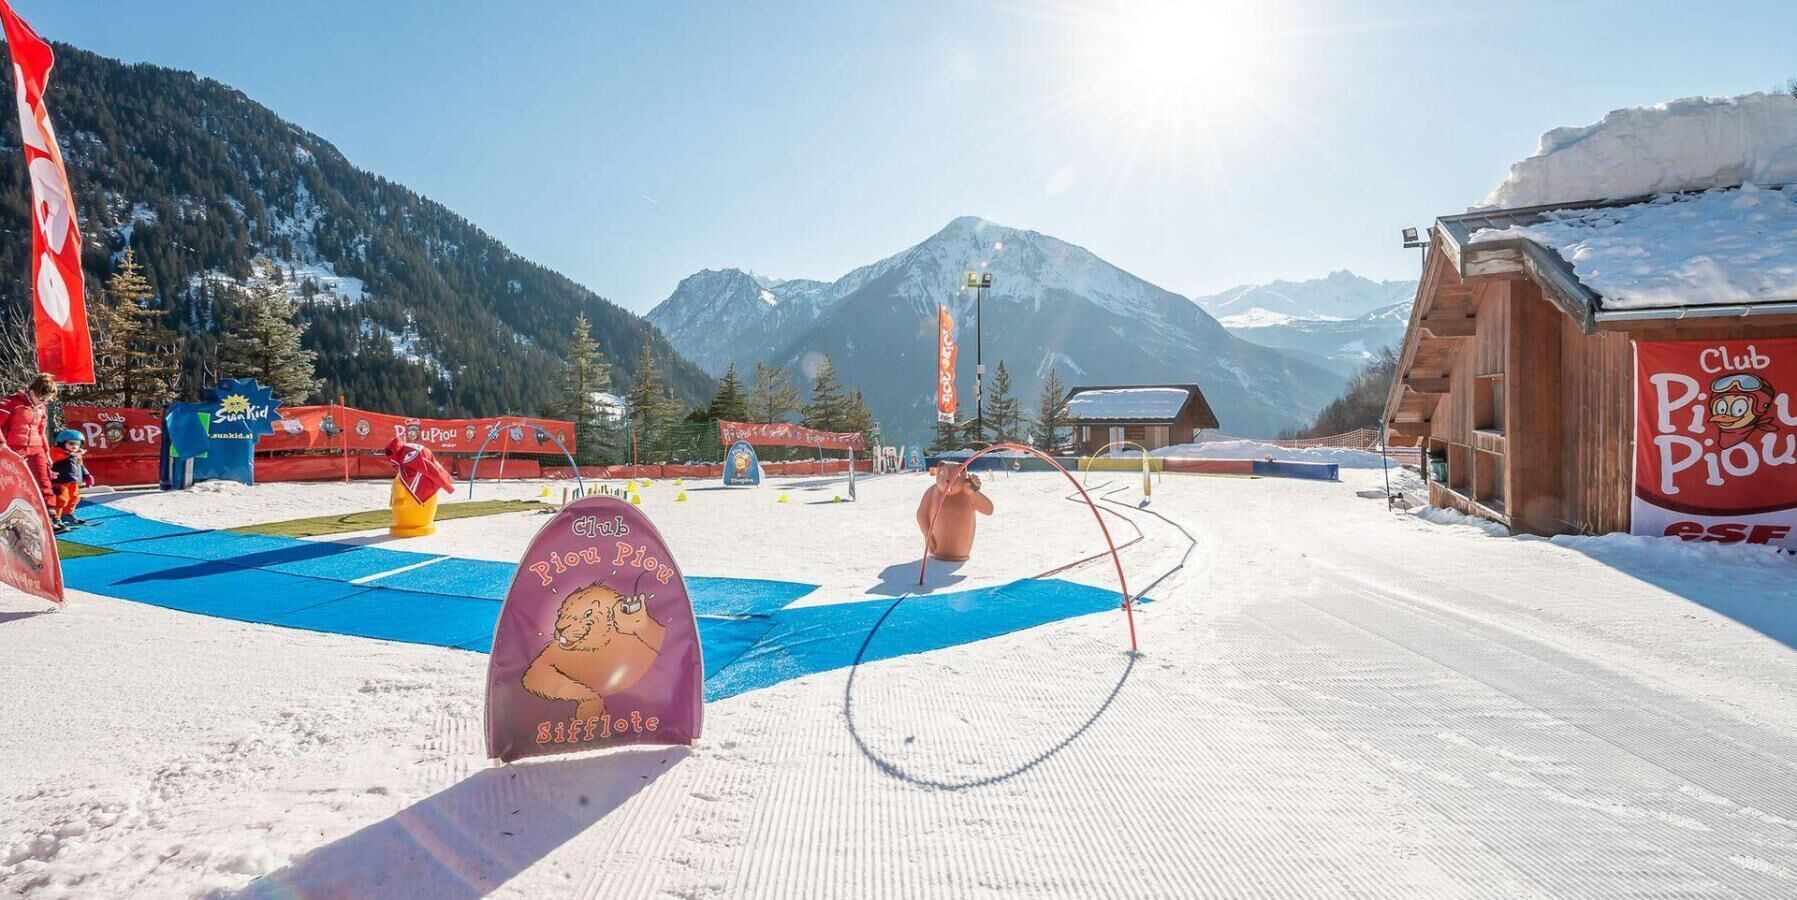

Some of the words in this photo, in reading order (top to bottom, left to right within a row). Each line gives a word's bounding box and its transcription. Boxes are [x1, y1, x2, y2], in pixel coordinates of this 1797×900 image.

[1700, 345, 1771, 373] Club
[97, 412, 126, 423] Club
[1653, 432, 1797, 494] Piou
[572, 515, 630, 537] Club
[528, 546, 601, 586] Piou
[612, 541, 675, 585] Piou
[536, 711, 660, 745] Sifflote
